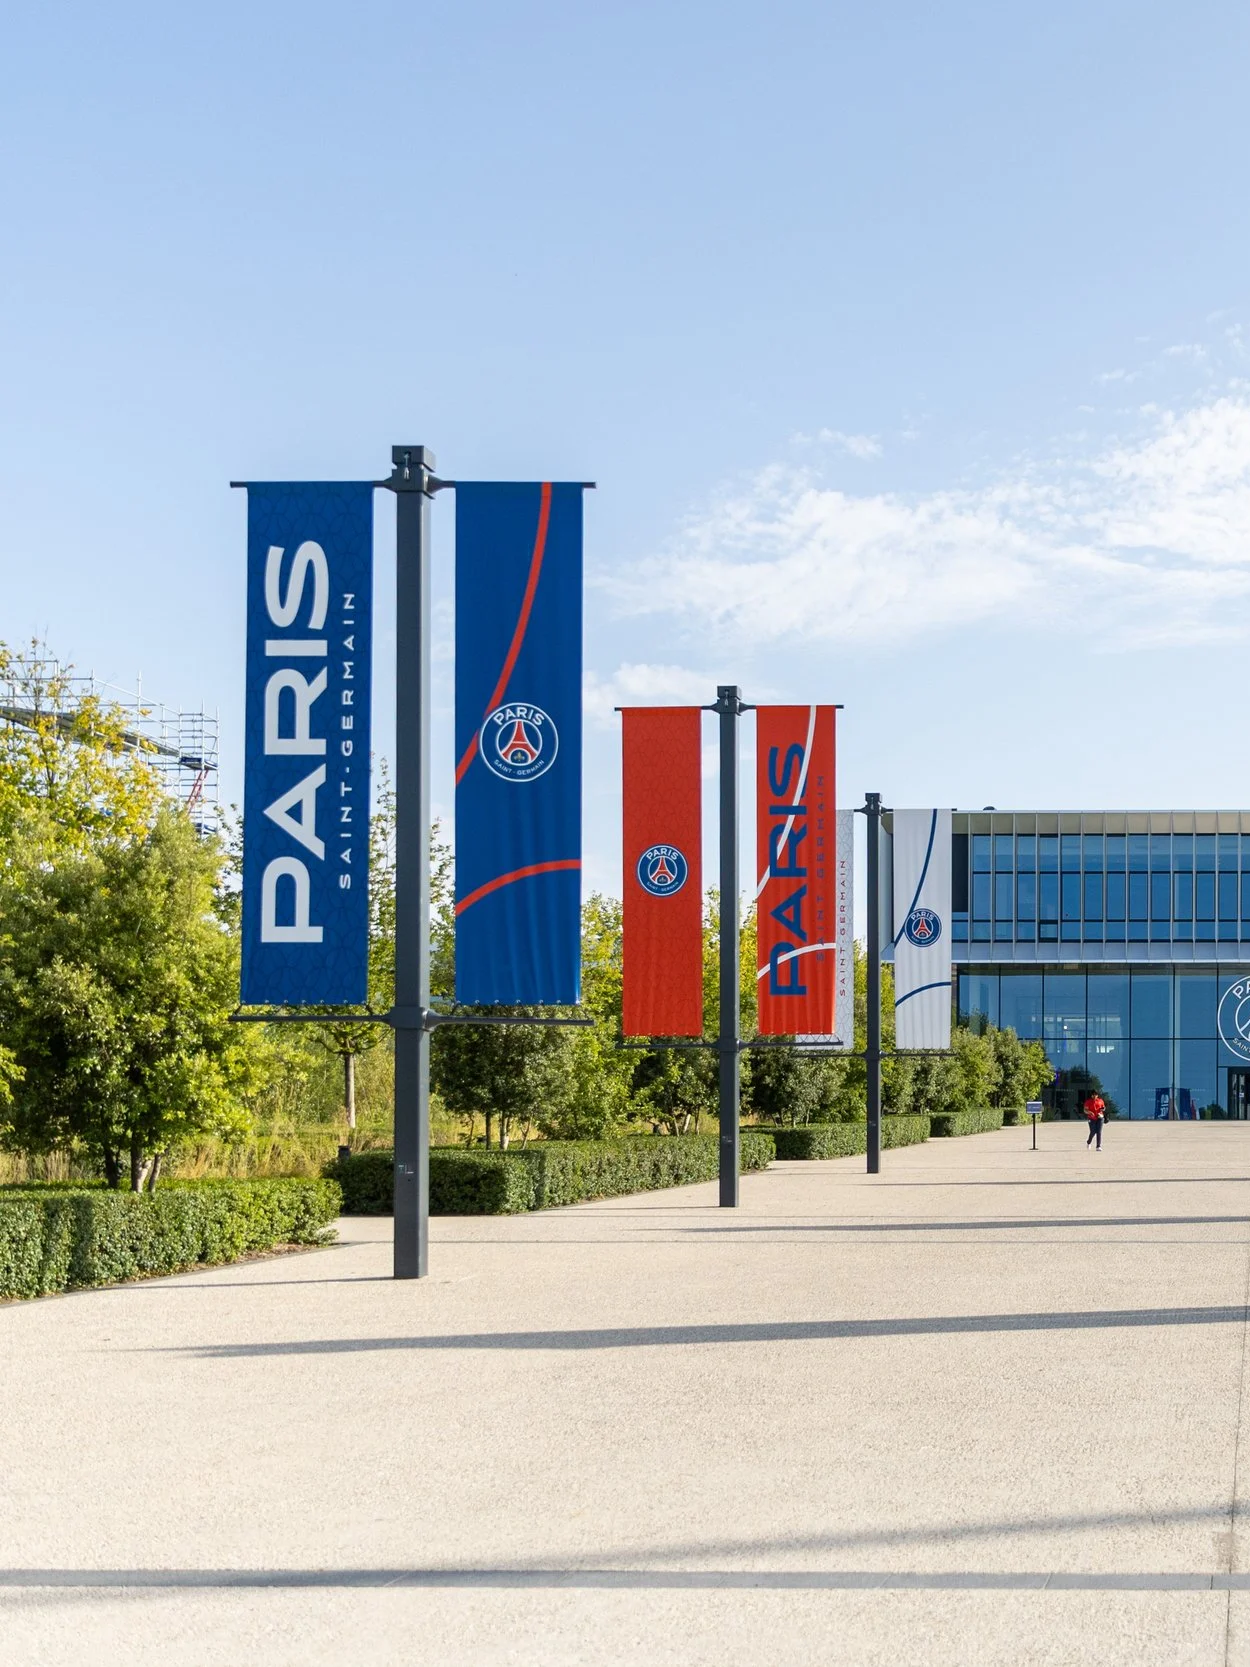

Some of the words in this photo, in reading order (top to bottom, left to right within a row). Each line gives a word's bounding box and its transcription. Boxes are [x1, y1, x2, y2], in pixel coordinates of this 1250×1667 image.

[261, 540, 329, 943] PARIS
[493, 707, 545, 726] PARIS
[646, 847, 679, 860] PARIS
[769, 743, 808, 996] PARIS
